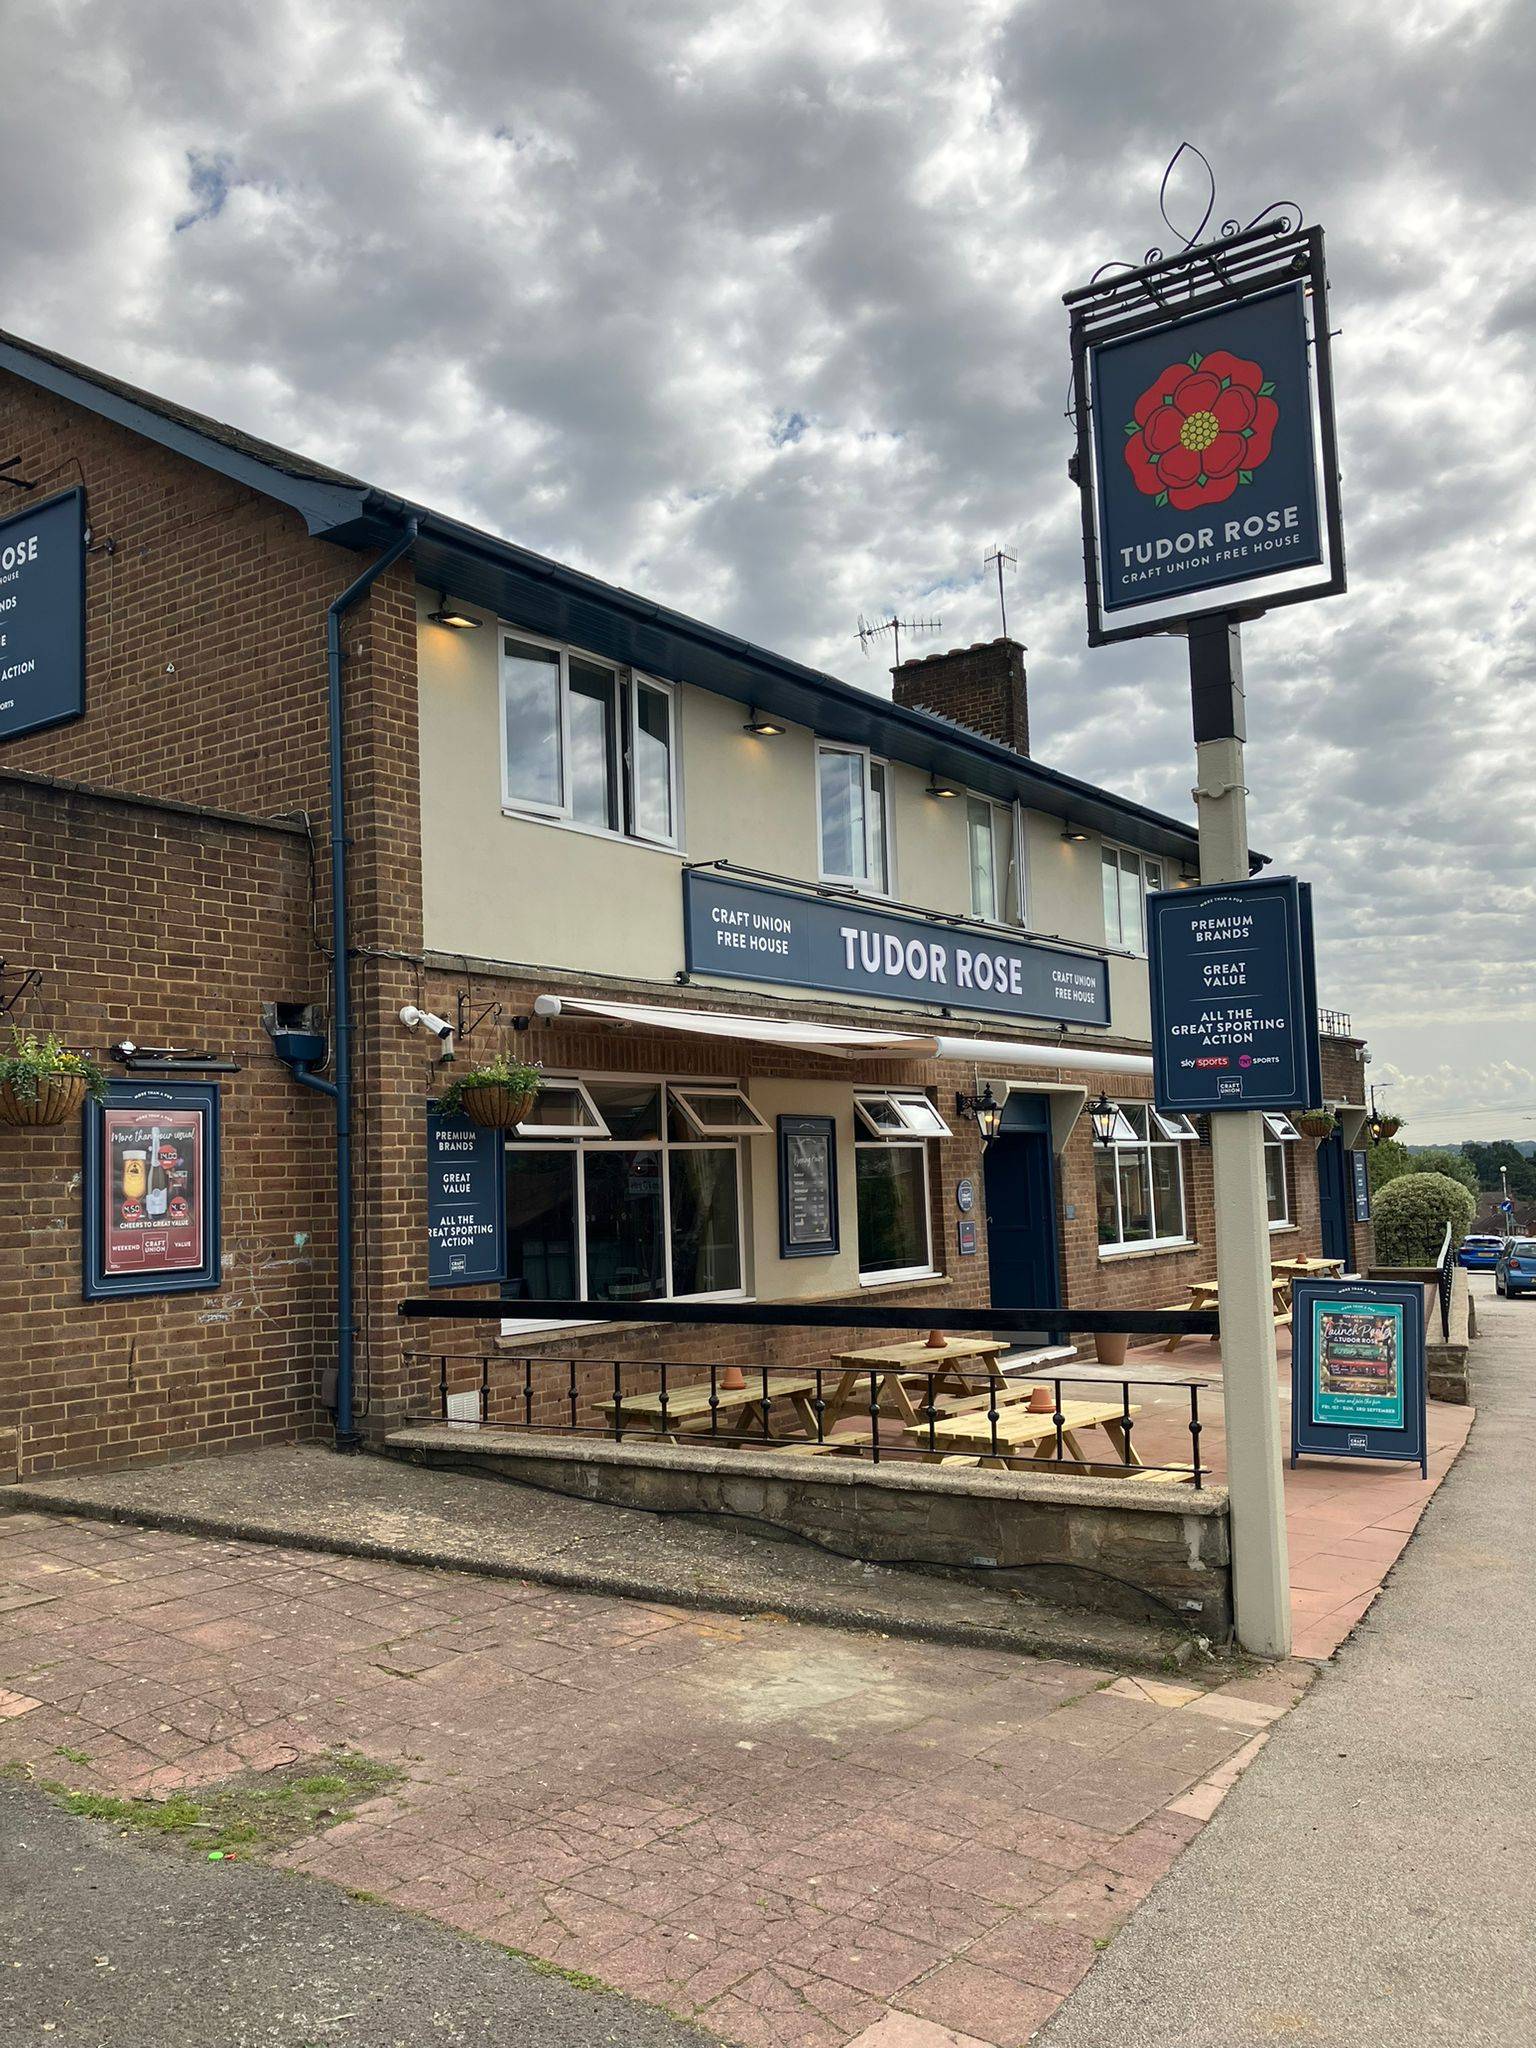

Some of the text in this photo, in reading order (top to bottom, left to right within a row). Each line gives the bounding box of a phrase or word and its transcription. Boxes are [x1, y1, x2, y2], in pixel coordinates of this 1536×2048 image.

[1120, 506, 1299, 566] TUDOR ROSE
[2, 536, 38, 570] OSE
[1122, 534, 1300, 584] CRAFT UNION FREE HOUSE
[2, 660, 34, 681] ACTION
[712, 907, 792, 934] CRAFT UNION
[1191, 915, 1253, 930] PREMIUM
[1196, 928, 1250, 942] BRANDS
[717, 930, 789, 955] FREE HOUSE
[840, 927, 1024, 996] TUDOR ROSE
[1204, 962, 1246, 975] GREAT
[1052, 970, 1096, 988] CRAFT UNION
[1204, 974, 1247, 987] VALUE
[1055, 987, 1095, 1004] FREE HOUSE
[1200, 1008, 1253, 1022] ALL THE
[1171, 1018, 1285, 1035] GREAT SPORTING
[1202, 1033, 1253, 1046] ACTION
[1180, 1058, 1228, 1068] sky sports
[111, 1132, 134, 1143] More
[174, 1128, 195, 1140] usual
[436, 1131, 476, 1140] PREMIUM
[439, 1142, 474, 1150] BRANDS
[443, 1173, 471, 1183] GREAT
[443, 1184, 471, 1193] VALUE
[440, 1215, 474, 1226] ALL THE
[428, 1224, 493, 1237] REAT SPORTING
[440, 1236, 474, 1247] ACTION
[1324, 1323, 1359, 1338] Launch
